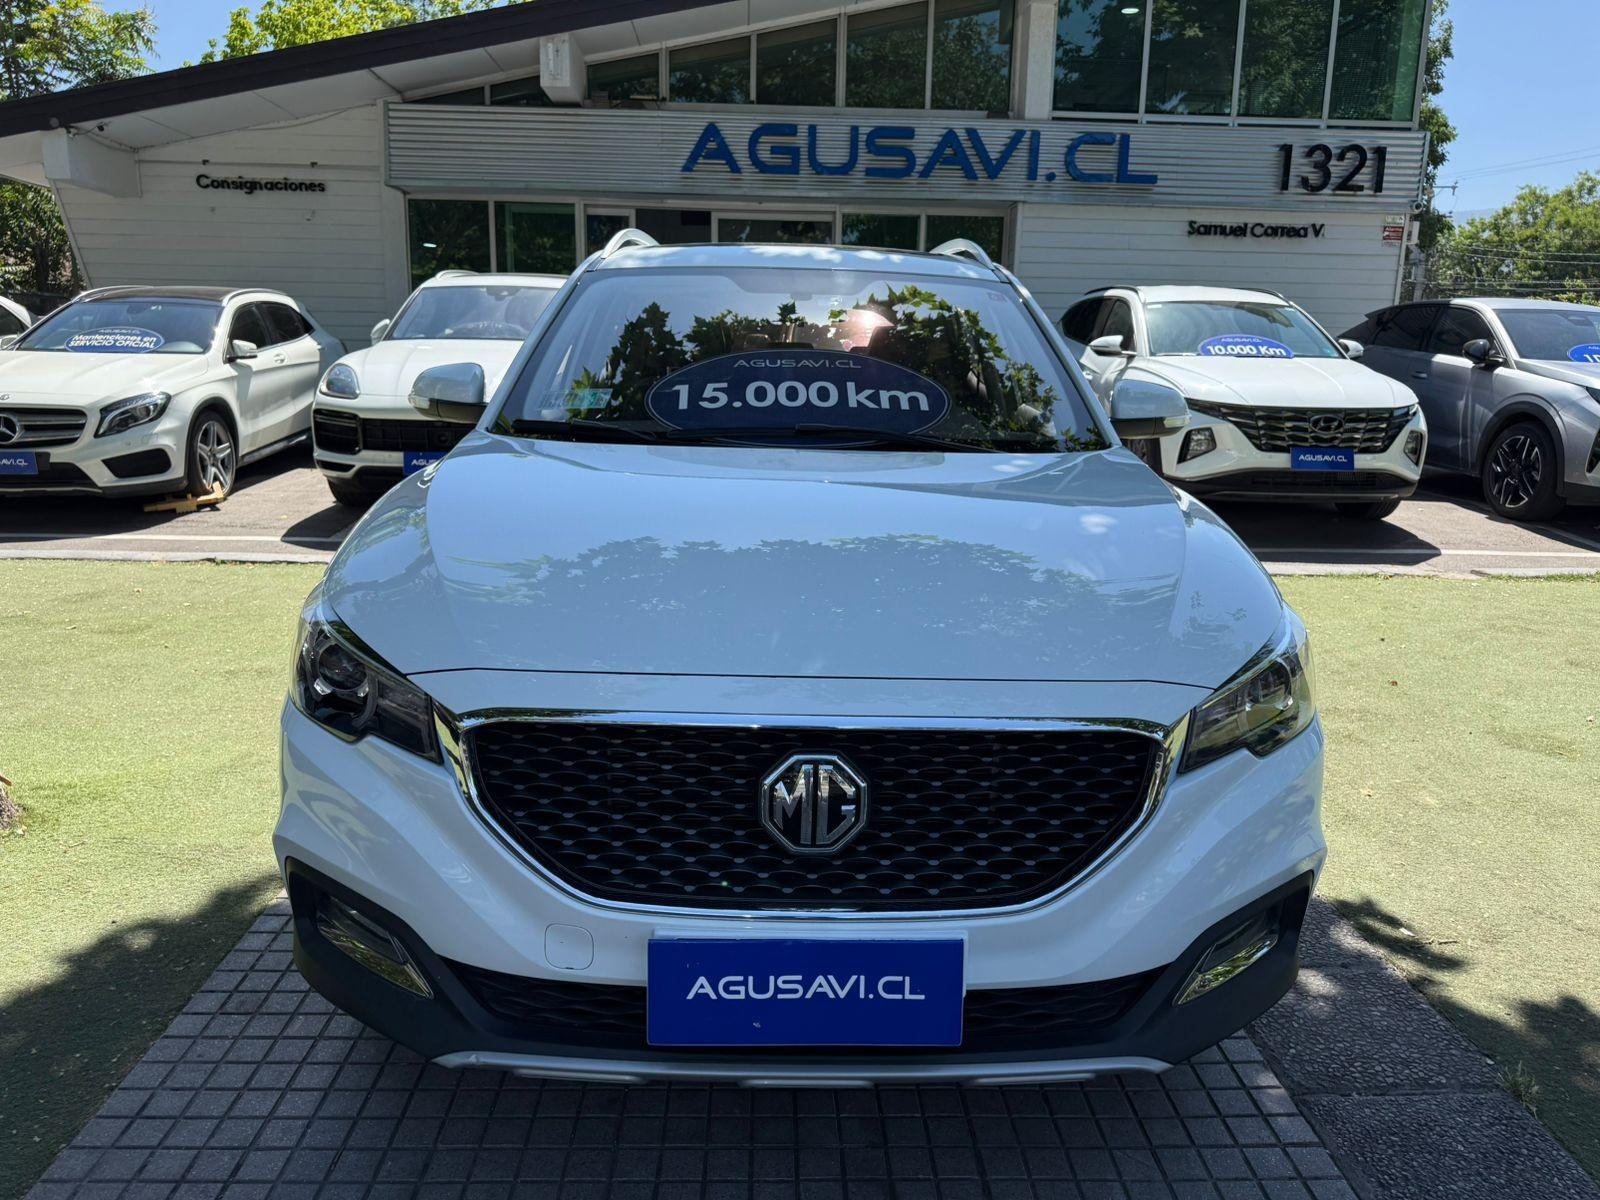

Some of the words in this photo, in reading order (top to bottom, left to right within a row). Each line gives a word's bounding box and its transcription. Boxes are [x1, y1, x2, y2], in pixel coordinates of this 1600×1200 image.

[681, 121, 1158, 185] AGUSAVI.CL
[1279, 143, 1388, 194] 1321
[196, 174, 326, 195] Consignaciones
[1187, 220, 1248, 238] Samuel
[1250, 222, 1308, 238] Correa
[68, 339, 115, 347] SERVICIO
[116, 340, 155, 349] OFICIAL
[1207, 345, 1258, 355] 10.000
[1259, 345, 1287, 356] Km
[733, 359, 861, 368] AGUSAVI.CL
[672, 381, 839, 410] 15.000
[846, 381, 930, 411] km
[1298, 454, 1348, 462] AGUSAVI.CL
[773, 764, 857, 845] MG
[686, 974, 926, 1000] AGUSAVI.CL
